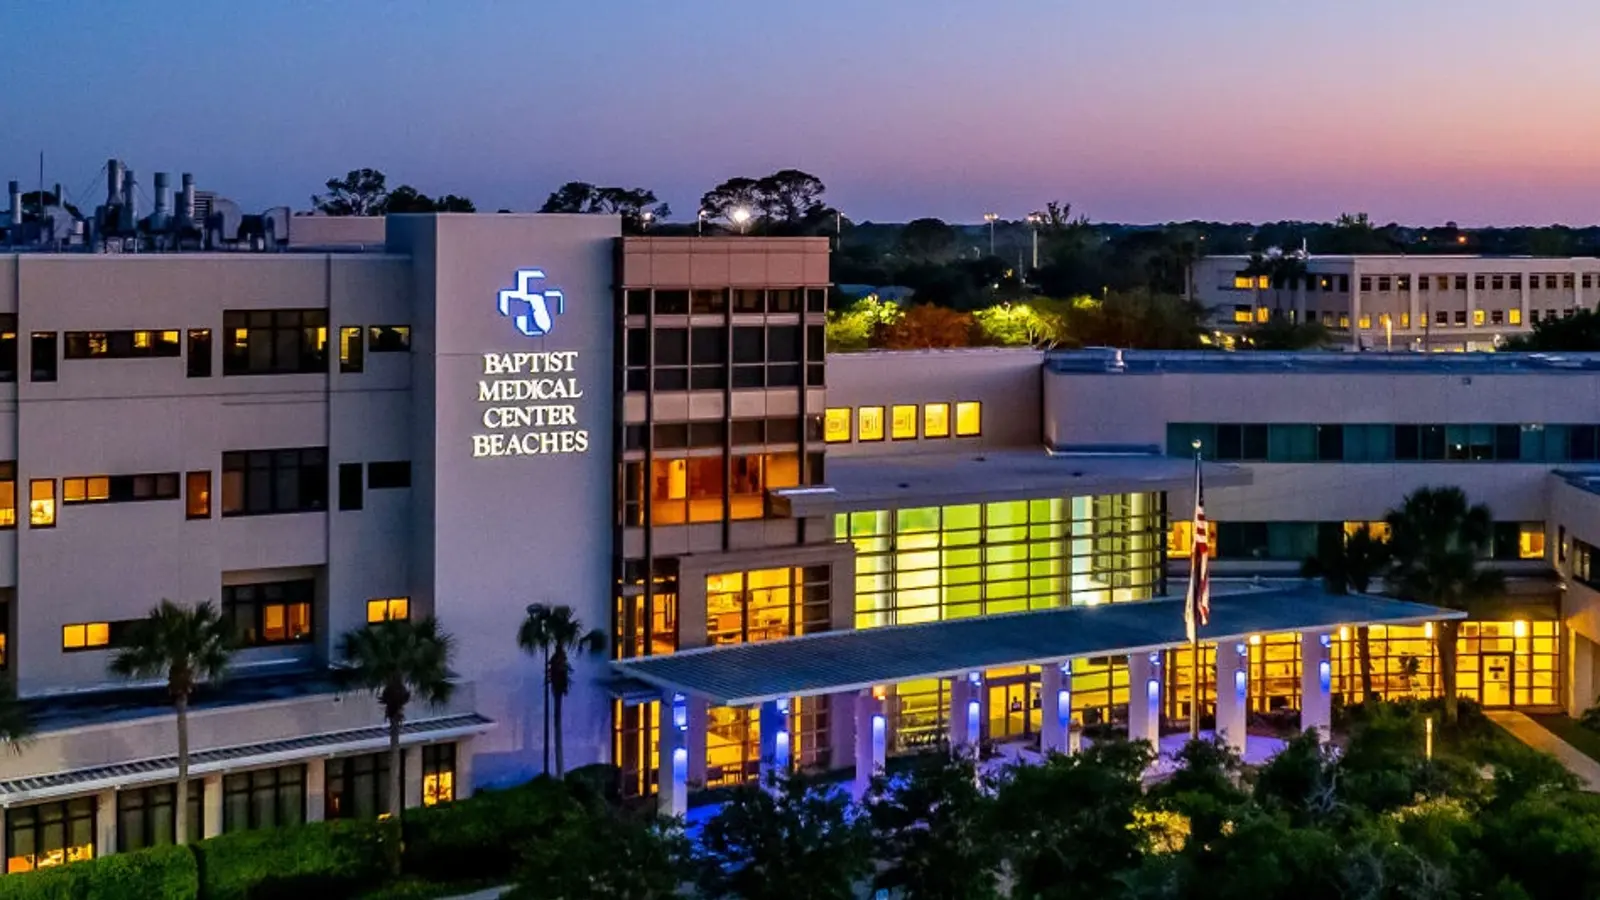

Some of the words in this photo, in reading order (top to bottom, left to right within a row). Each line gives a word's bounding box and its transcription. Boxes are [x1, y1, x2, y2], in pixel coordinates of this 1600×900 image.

[484, 352, 578, 374] BAPTIST
[479, 378, 583, 401] MEDICAL
[483, 405, 577, 428] CENTER
[473, 431, 588, 457] BEACHES
